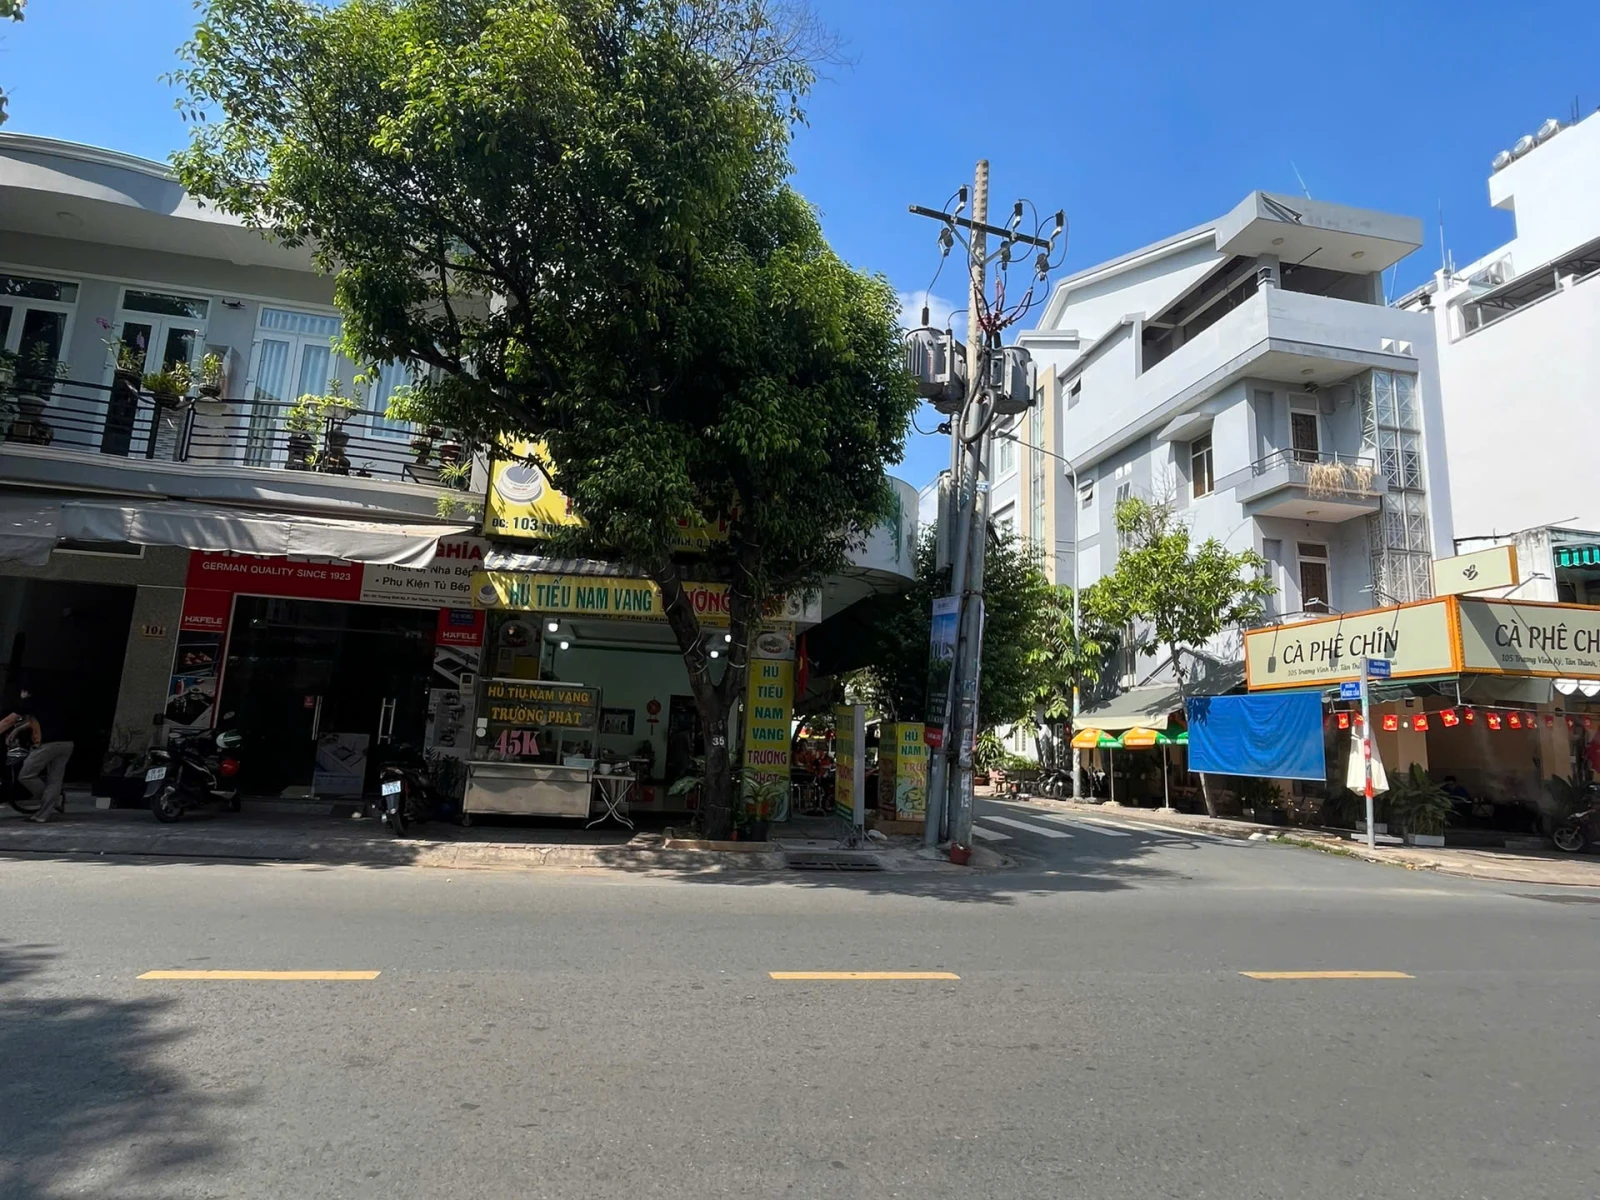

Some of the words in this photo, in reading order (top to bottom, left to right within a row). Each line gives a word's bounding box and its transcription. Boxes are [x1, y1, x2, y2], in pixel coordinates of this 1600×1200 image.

[513, 516, 539, 531] 103
[202, 561, 248, 573] GERMAN
[250, 565, 294, 577] QUALITY
[296, 569, 327, 580] SINCE
[330, 572, 351, 581] 1923
[450, 581, 471, 593] Bếp
[509, 575, 531, 607] HỦ
[536, 575, 571, 608] TIẾU
[575, 585, 609, 610] NAM
[614, 587, 653, 612] VANG
[1494, 619, 1522, 648] CÀ
[1529, 622, 1568, 651] PHÊ
[1573, 629, 1600, 654] CH
[1283, 639, 1304, 665] CÀ
[1310, 633, 1345, 662] PHÊ
[1501, 653, 1514, 662] 105
[762, 662, 779, 678] HỦ
[558, 690, 590, 703] VANG
[757, 683, 784, 699] TIẾU
[754, 706, 784, 720] NAM
[752, 727, 785, 741] VANG
[494, 729, 540, 756] 45K
[901, 745, 922, 756] NAM
